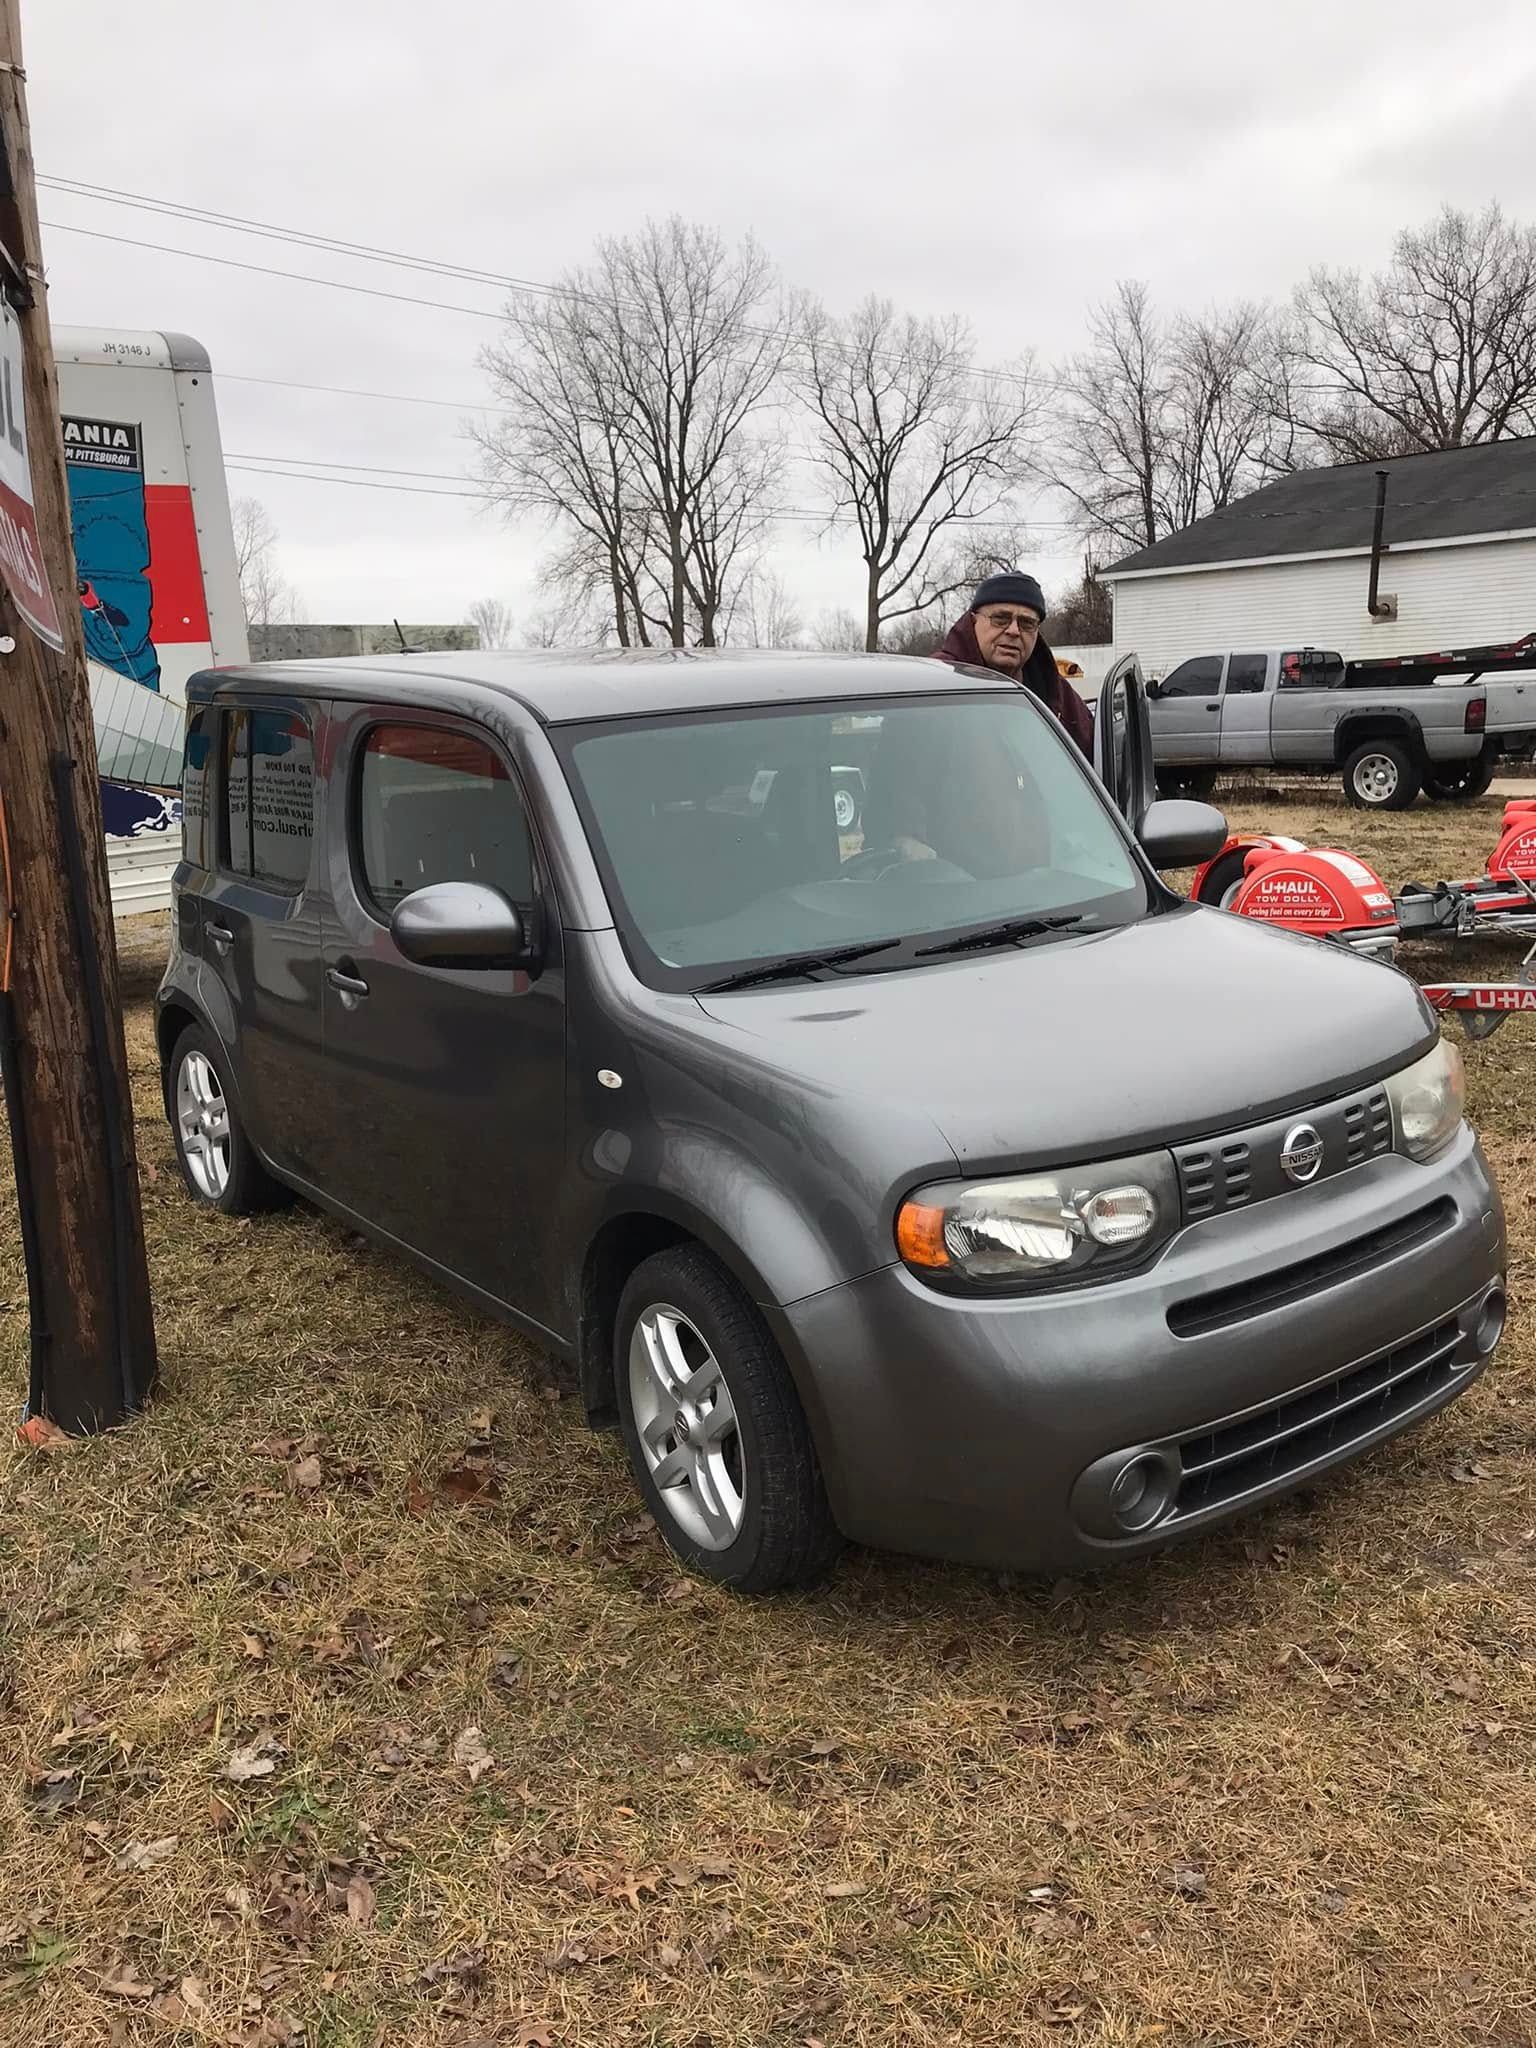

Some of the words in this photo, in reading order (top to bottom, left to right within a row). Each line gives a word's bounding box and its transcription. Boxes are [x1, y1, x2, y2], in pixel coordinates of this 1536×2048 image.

[102, 343, 117, 353] JH
[144, 345, 151, 356] J
[61, 421, 129, 447] ANIA
[75, 449, 130, 465] PITTSBURGH
[1519, 838, 1536, 848] U-
[1261, 881, 1318, 894] U-HAUL
[1256, 895, 1278, 903] TOW
[1283, 895, 1322, 903] DOLLY
[1248, 907, 1269, 917] Saving
[1269, 907, 1283, 917] fuel
[1283, 908, 1293, 916] on
[1293, 908, 1314, 917] every
[1289, 1146, 1321, 1164] NISSAN
